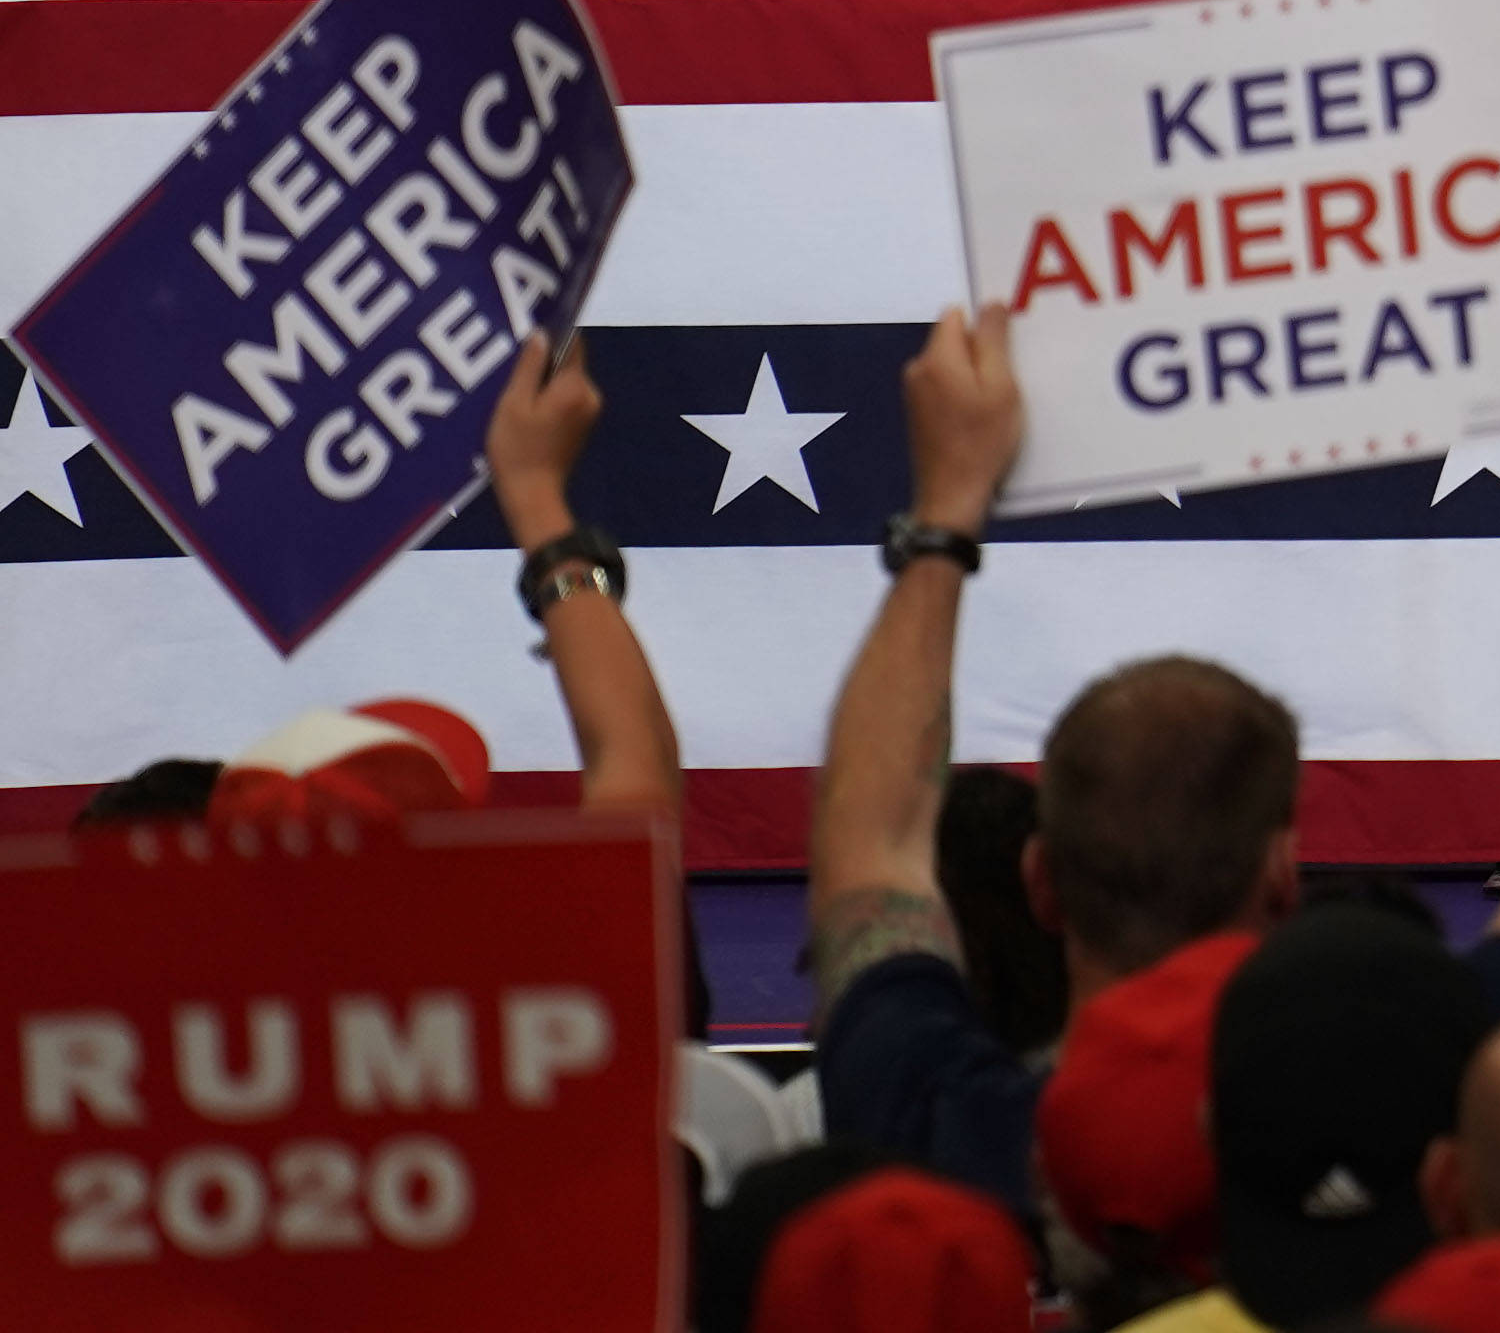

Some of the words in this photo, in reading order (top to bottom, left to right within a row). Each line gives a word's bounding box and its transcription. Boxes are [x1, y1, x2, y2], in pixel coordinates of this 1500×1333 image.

[190, 31, 424, 300] KEEP
[1147, 51, 1440, 165] KEEP
[170, 17, 586, 508] AMERICA
[302, 155, 588, 503] GREAT!
[16, 980, 620, 1131] RUMP
[50, 1130, 479, 1269] 2020
